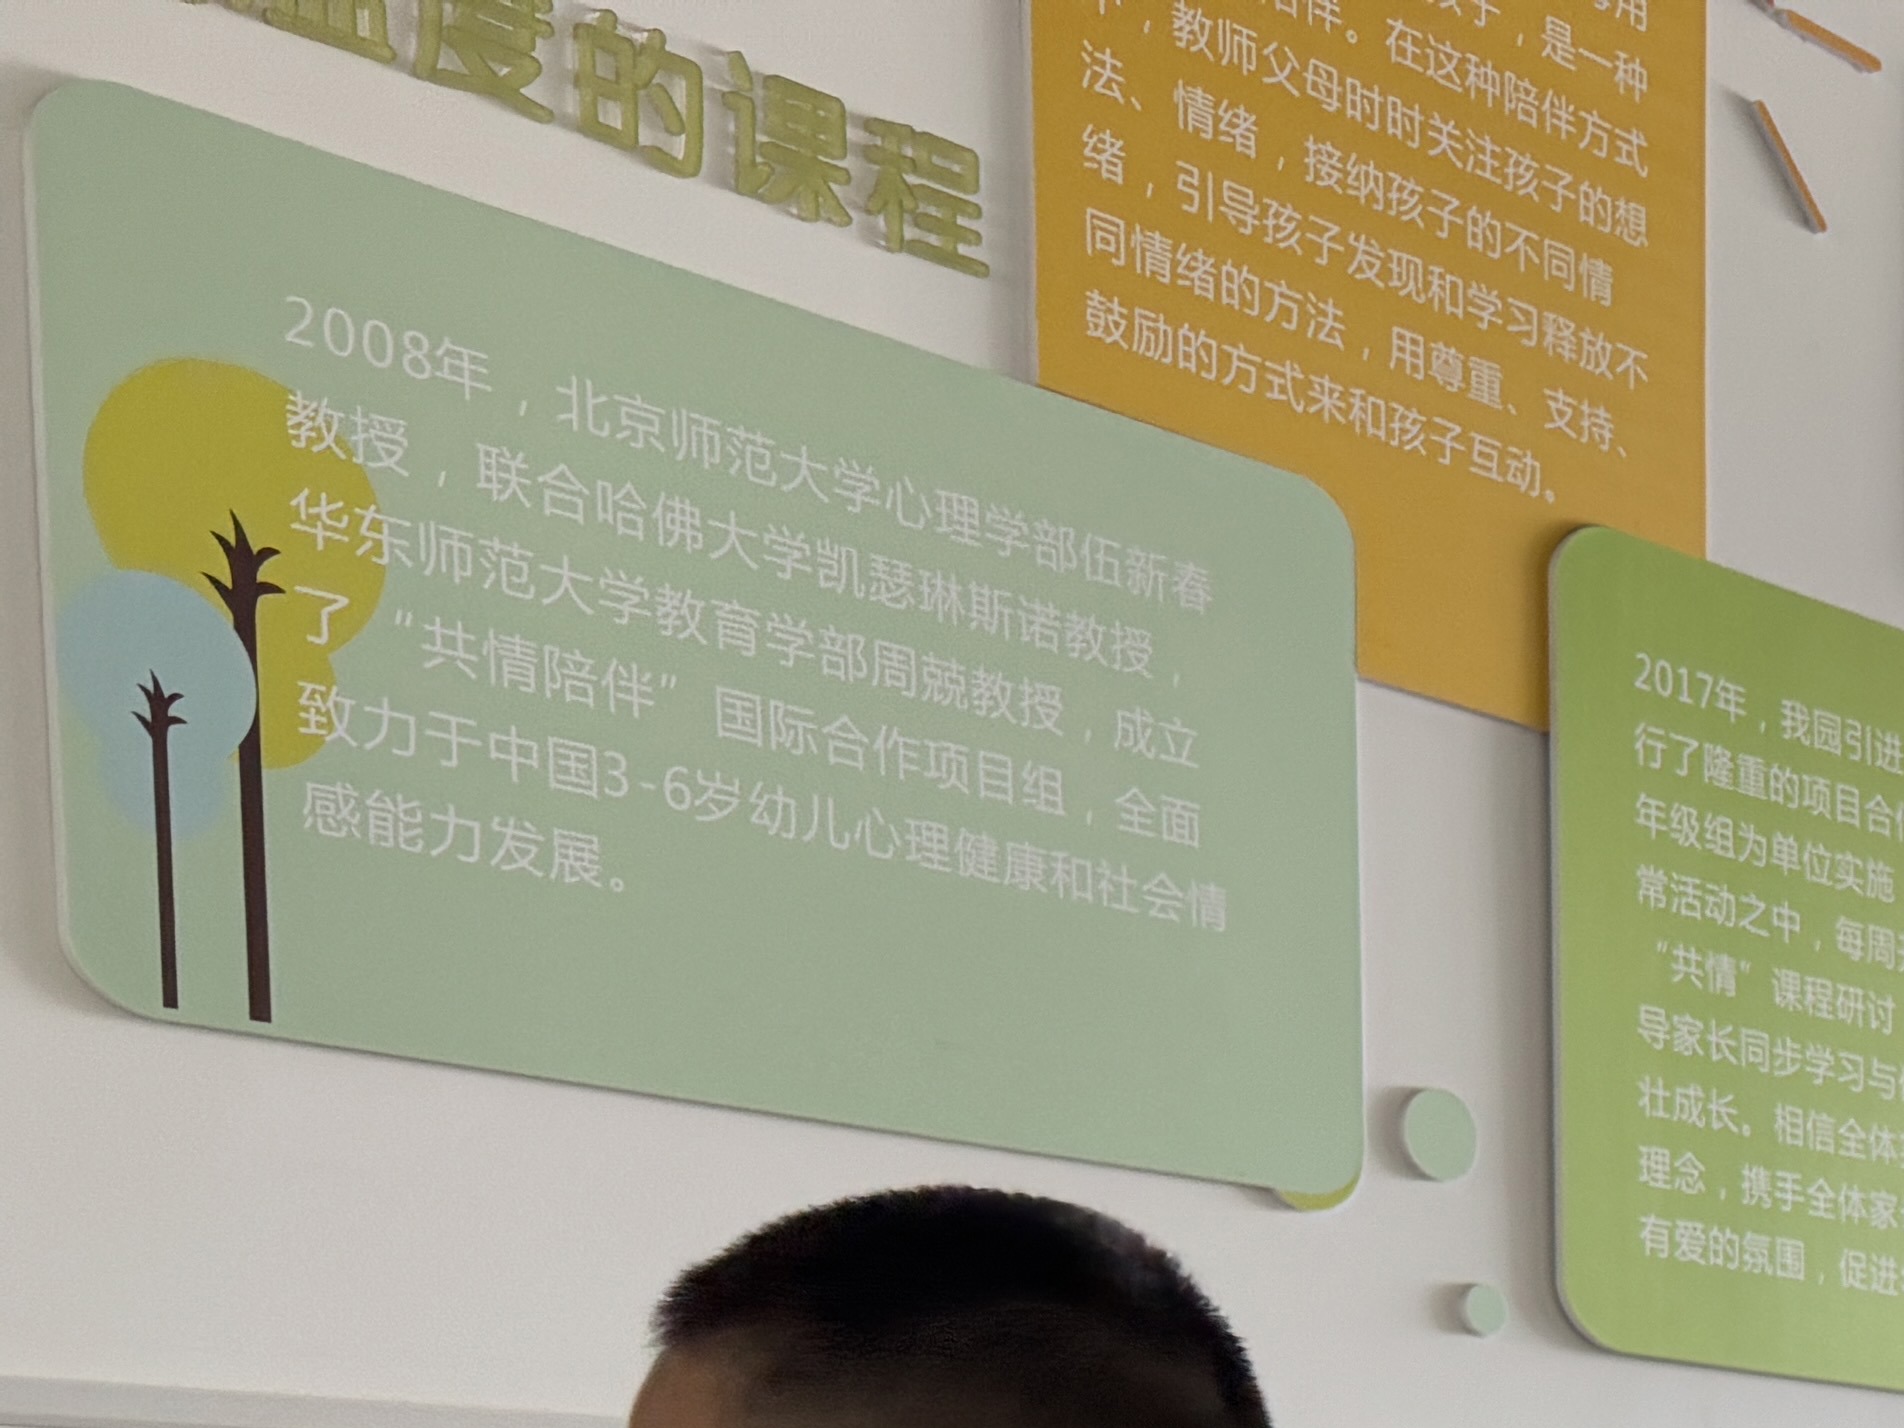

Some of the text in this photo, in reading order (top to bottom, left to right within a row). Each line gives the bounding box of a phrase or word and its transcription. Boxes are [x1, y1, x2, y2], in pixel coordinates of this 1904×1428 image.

[1099, 0, 1648, 247] ，教师父母时时关注孩子的想
[1085, 289, 1556, 503] 鼓励的方式来和孩子互动。
[303, 781, 625, 893] 感能力发展。
